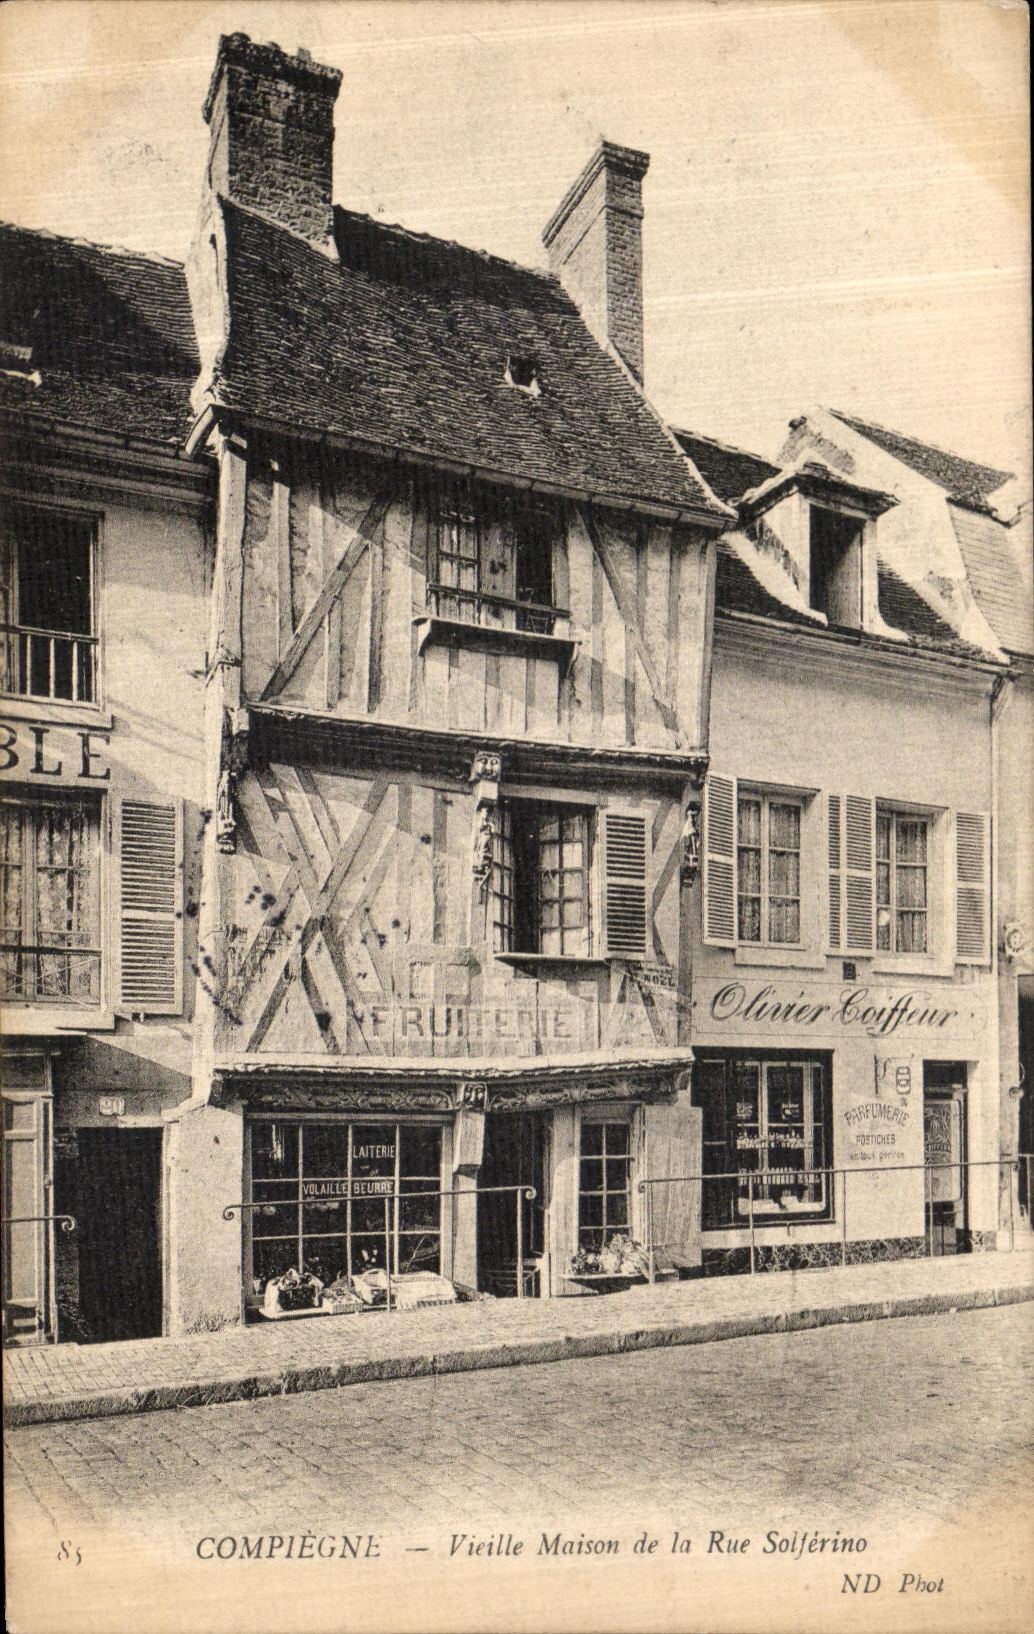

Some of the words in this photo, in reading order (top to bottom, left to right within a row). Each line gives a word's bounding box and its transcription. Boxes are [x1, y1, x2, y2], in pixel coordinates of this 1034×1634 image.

[710, 982, 831, 1026] Olivier
[832, 988, 959, 1038] Coiffeur
[844, 1103, 910, 1127] PARFUMERIE
[856, 1134, 896, 1146] POSTICHES
[353, 1145, 395, 1159] LAITERIE
[303, 1182, 349, 1196] VOLAILLE
[353, 1181, 394, 1195] BEURRE
